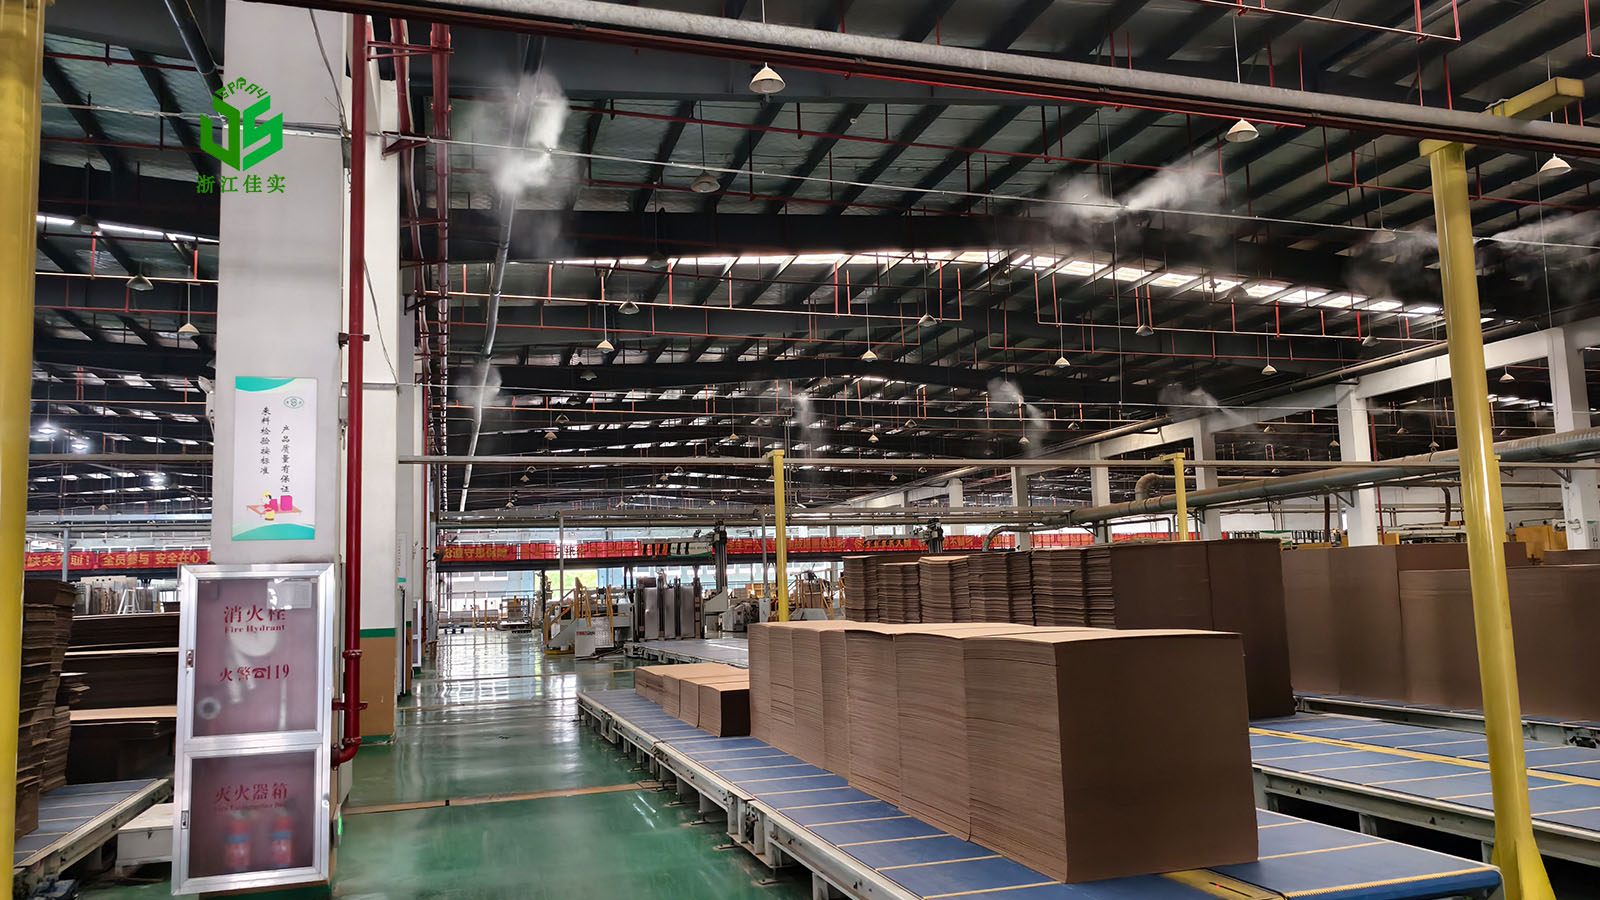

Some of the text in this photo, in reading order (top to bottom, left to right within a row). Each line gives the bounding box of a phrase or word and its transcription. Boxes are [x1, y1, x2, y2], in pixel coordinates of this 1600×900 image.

[280, 425, 290, 493] 产品质量有保证
[103, 553, 149, 566] 全员参与
[155, 551, 201, 564] 安全在心
[224, 604, 286, 623] 消火栓
[225, 624, 285, 633] Fire Hydrant
[215, 782, 288, 801] 灭火器箱
